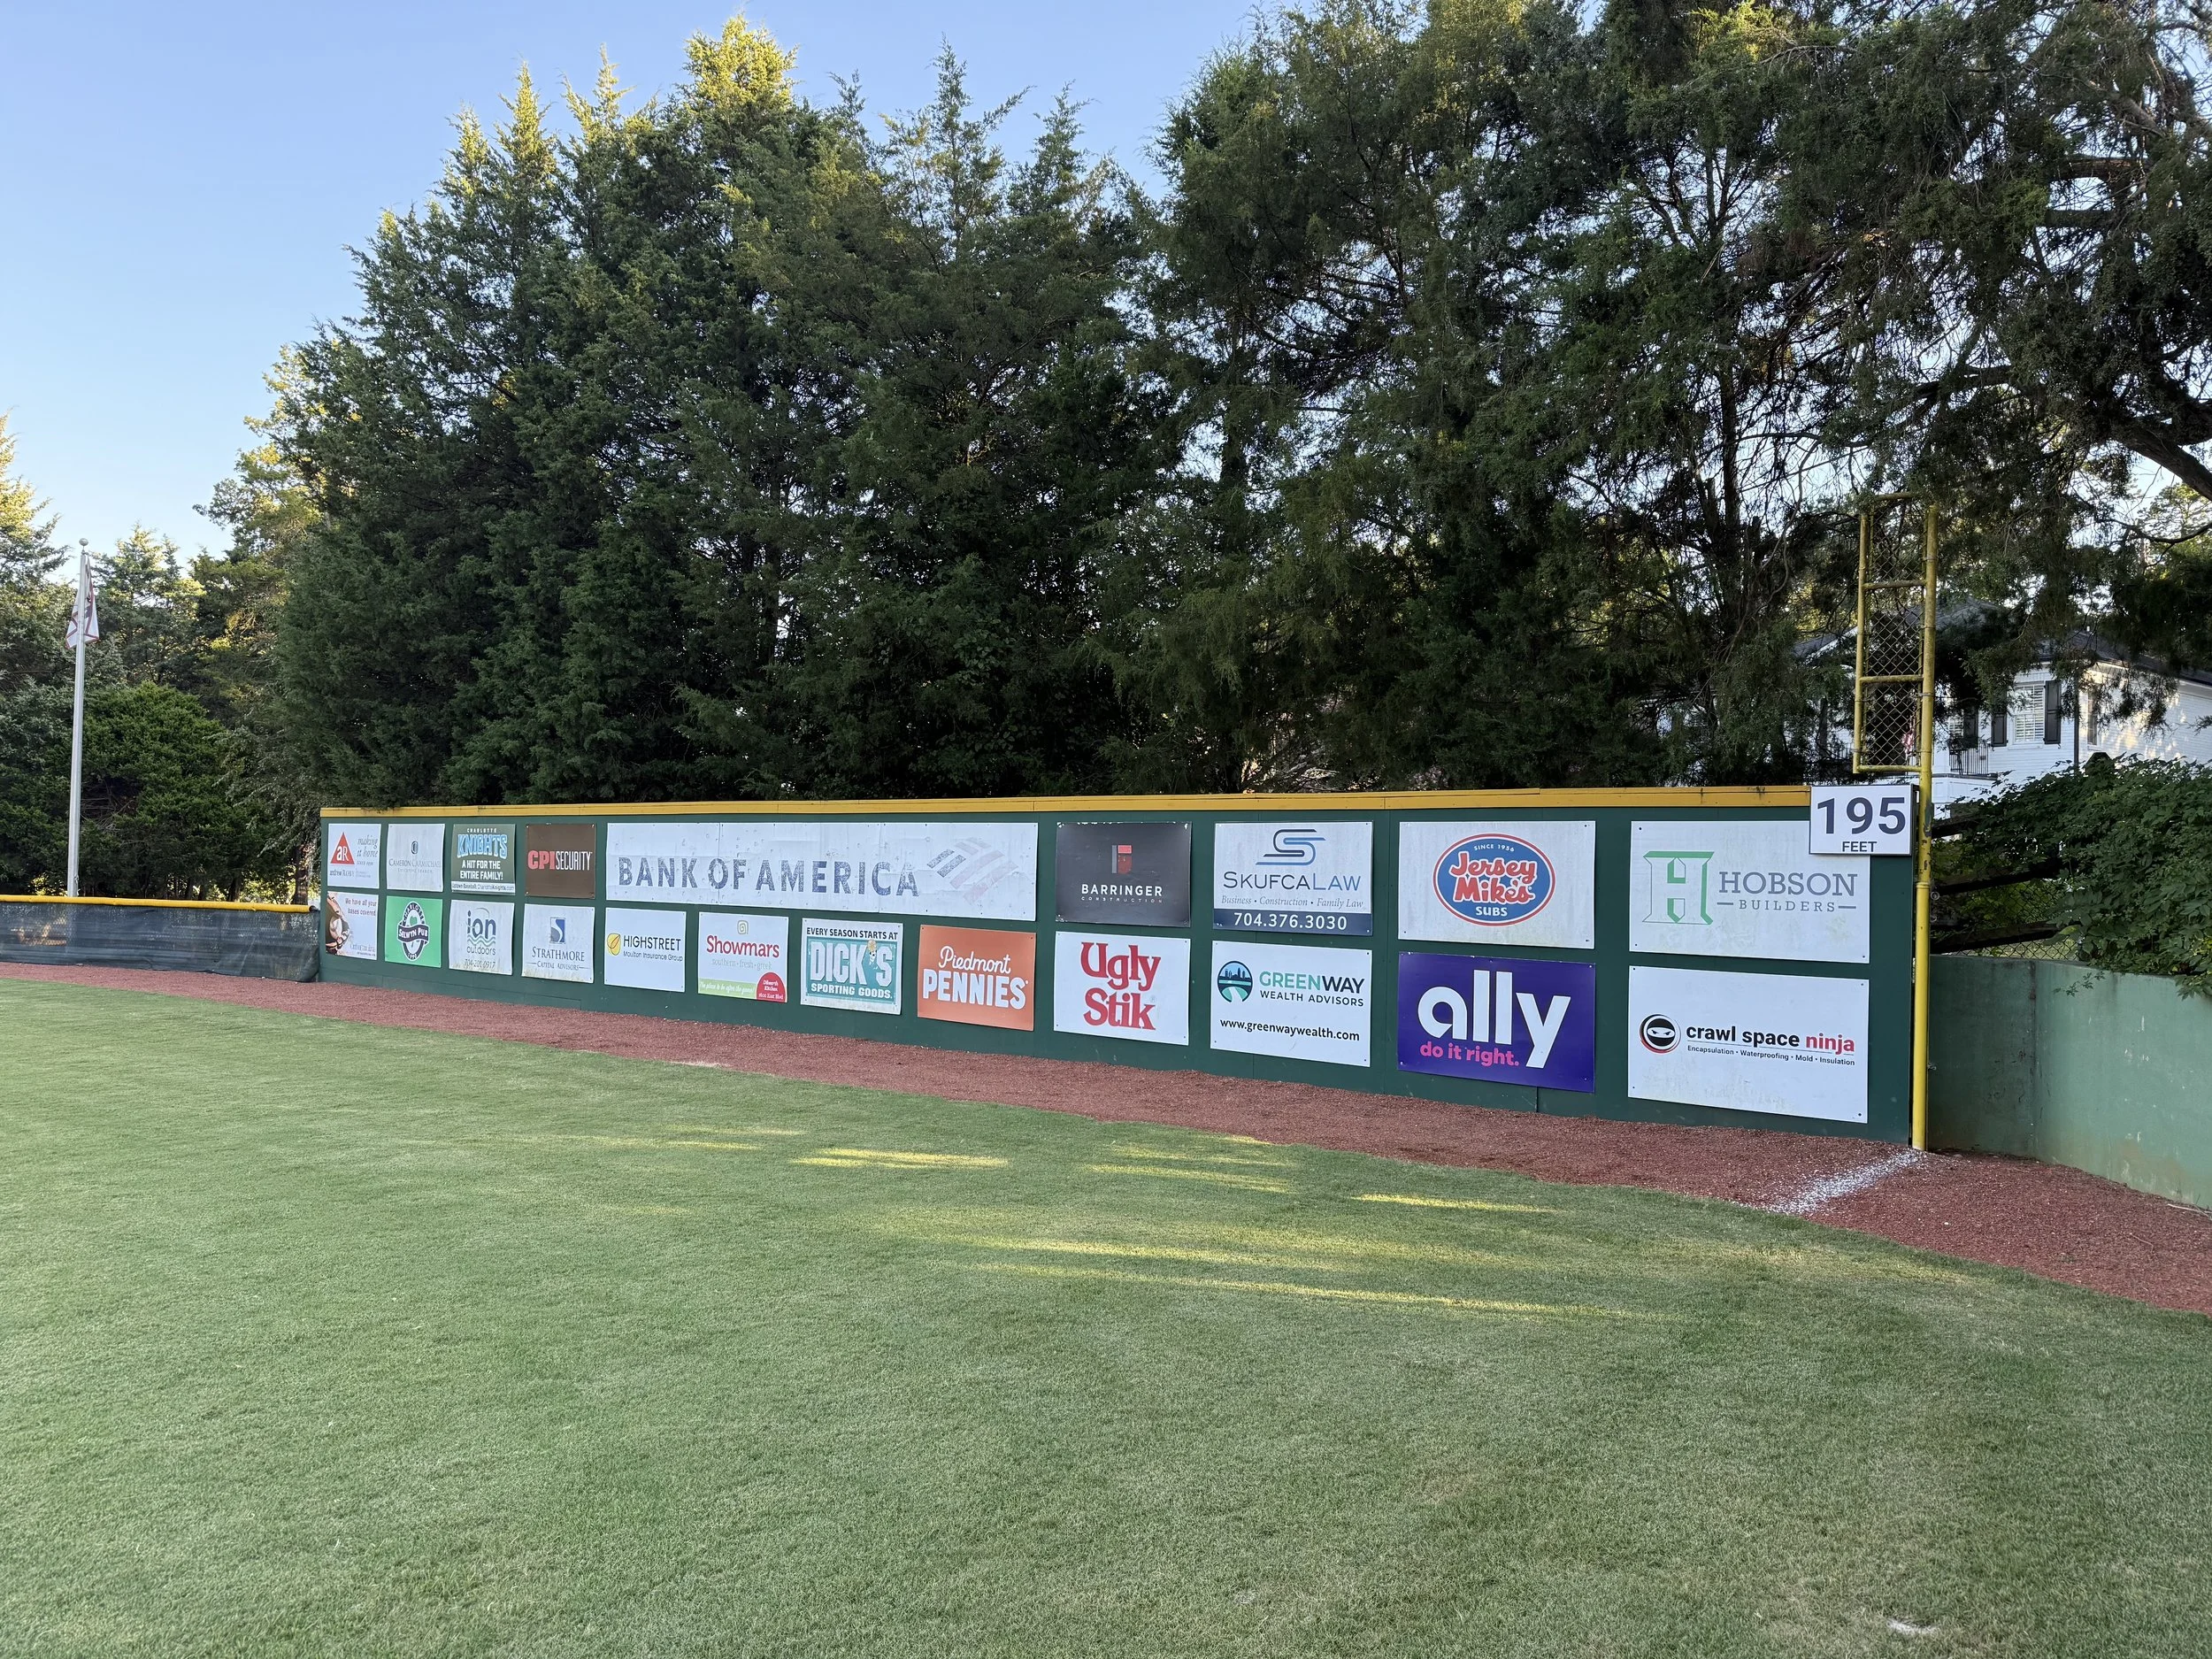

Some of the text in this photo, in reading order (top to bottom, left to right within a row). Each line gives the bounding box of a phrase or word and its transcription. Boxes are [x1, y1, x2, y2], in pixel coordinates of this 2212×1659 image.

[1816, 796, 1907, 835] 195
[457, 833, 508, 859] KNIGHTS
[1842, 841, 1877, 853] FEET
[460, 871, 503, 880] ENTIRE FAMILY!
[466, 860, 476, 869] HIT
[476, 860, 488, 869] FOR
[489, 860, 501, 870] THE
[1448, 851, 1538, 884] Jersey
[618, 856, 920, 897] BANK OF AMERICA
[1718, 871, 1858, 896] HOBSON
[1081, 884, 1163, 897] BARRINGER
[1453, 876, 1536, 905] Mike's
[1221, 895, 1363, 910] Business Construction Family Law
[1475, 906, 1508, 917] SUBS
[1740, 900, 1835, 912] BUILDERS
[467, 910, 496, 940] ion
[1233, 912, 1348, 930] 704.376.3030
[623, 935, 681, 951] HIGHSTREET
[806, 926, 898, 941] EVERY SEASON STARTS AT
[466, 944, 496, 956] outdoors
[532, 946, 585, 962] STRATHMORE
[706, 934, 780, 958] Showmars
[557, 963, 580, 972] ADVISORS
[711, 958, 736, 967] southern
[739, 959, 754, 969] fresh
[938, 945, 1011, 975] Piedmont
[1080, 941, 1162, 992] Ugly
[810, 983, 856, 995] SPORTING
[923, 968, 1026, 1010] PENNIES
[1259, 971, 1365, 995] GREENWAY
[1083, 987, 1156, 1031] Stik
[1259, 990, 1364, 1007] WEALTH ADVISORS
[1417, 969, 1571, 1069] ally
[1219, 1019, 1361, 1041] www.greenwaywealth.com
[1686, 1025, 1855, 1056] crawl space ninja
[1419, 1041, 1520, 1067] do it right.
[1687, 1045, 1855, 1066] Encapsulation Waterproofing Mold Insulation
